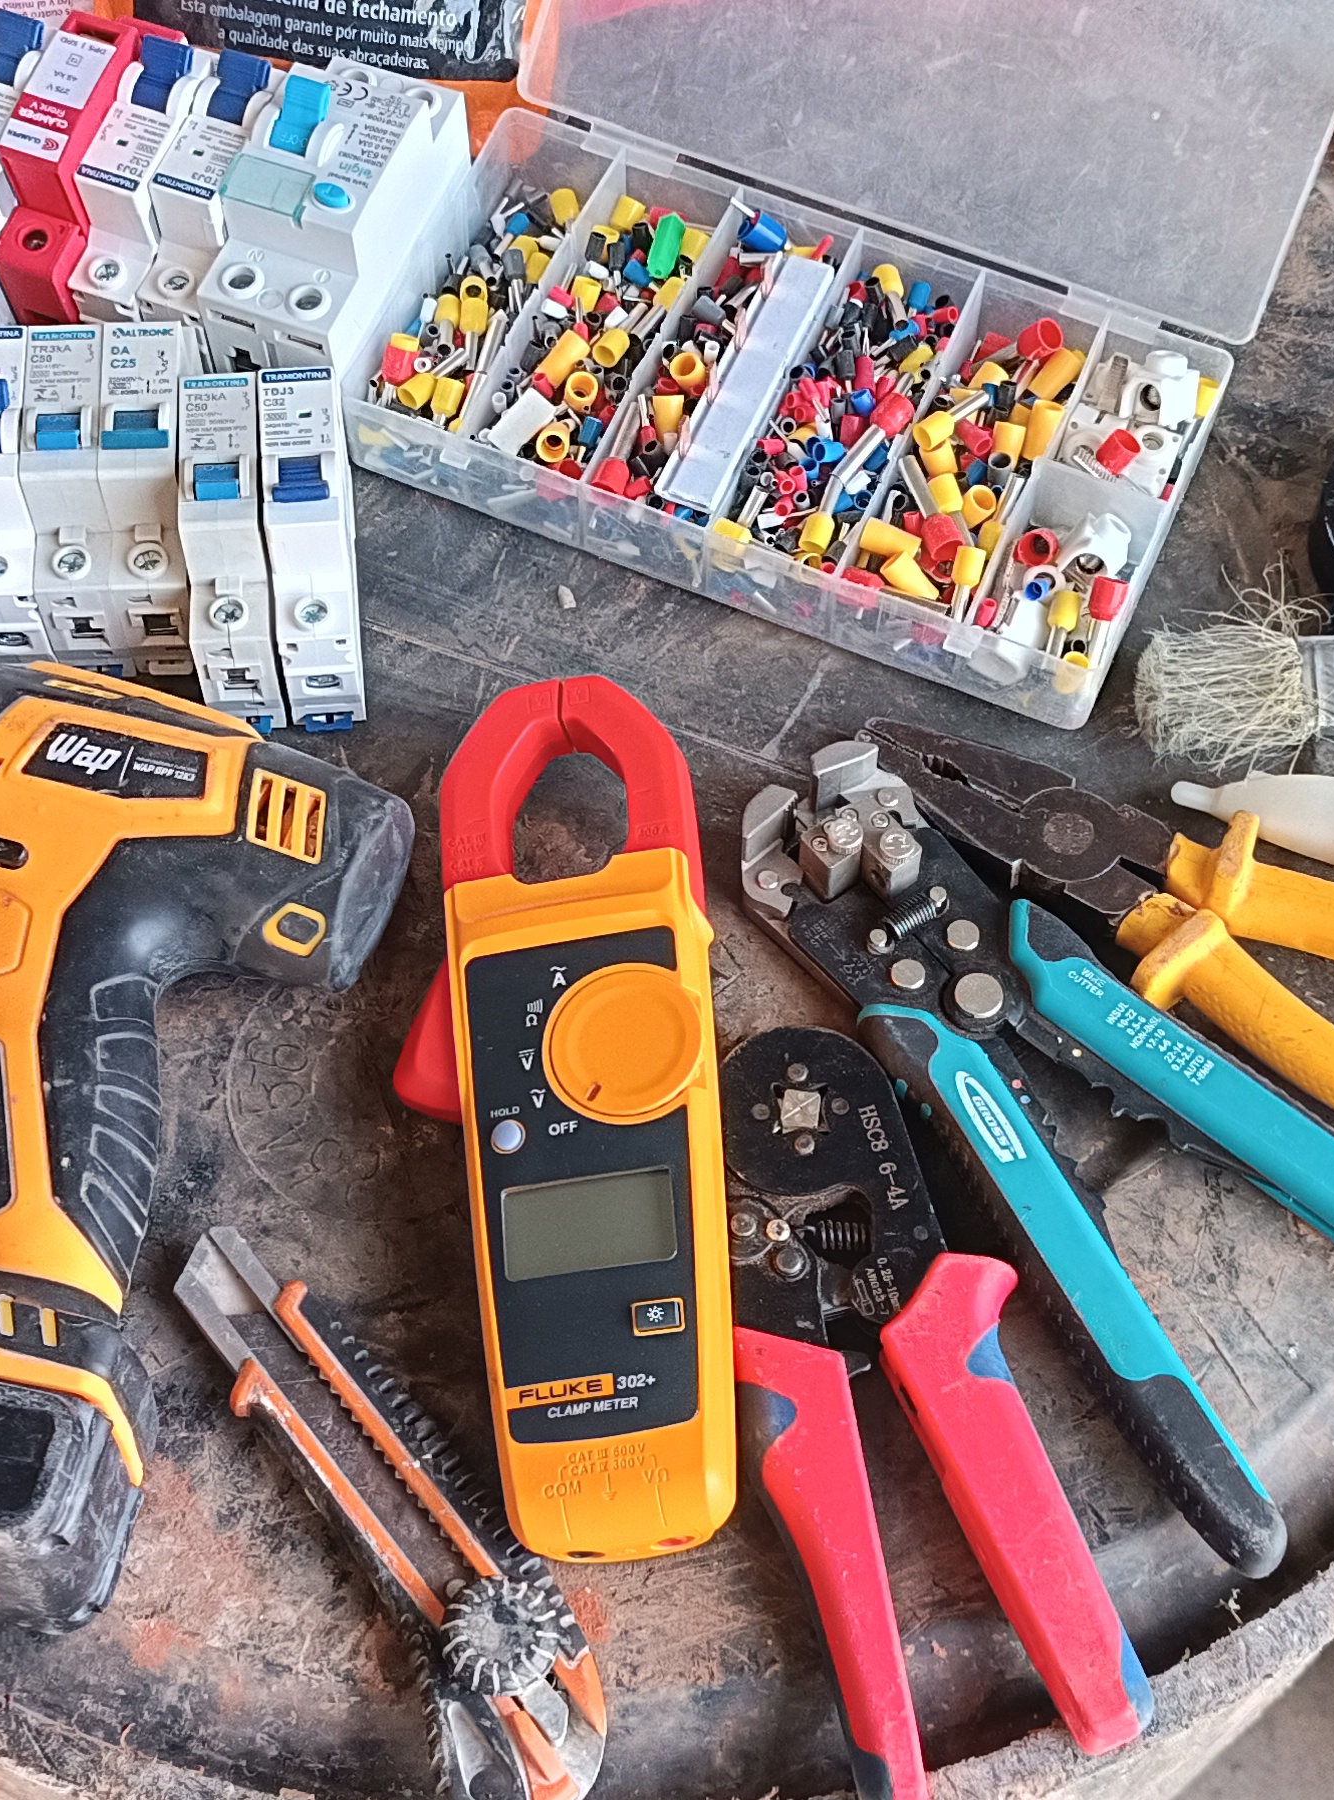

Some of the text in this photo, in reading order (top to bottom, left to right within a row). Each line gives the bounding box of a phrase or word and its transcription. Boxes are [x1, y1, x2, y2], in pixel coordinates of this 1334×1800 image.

[325, 0, 347, 14] de
[352, 0, 457, 26] fechamento
[180, 0, 207, 14] Esta
[210, 2, 281, 28] embalagem
[284, 17, 334, 36] garante
[335, 26, 358, 42] por
[360, 28, 397, 45] muito
[399, 32, 428, 49] mais
[217, 28, 430, 70] a qualidade das suas abraçadeiras.
[17, 105, 69, 129] CLAMPER
[79, 165, 136, 190] TRAMONTINA
[339, 161, 374, 180] elgin
[156, 175, 212, 197] TRAMONTINA
[32, 331, 94, 341] TRAMONTINA
[30, 344, 73, 355] TR3kA
[30, 354, 53, 364] C50
[110, 346, 131, 356] DA
[110, 358, 137, 369] C25
[185, 380, 246, 388] TRAMONTINA
[265, 371, 329, 382] TRAMONTINA
[185, 392, 228, 402] TR3kA
[262, 386, 295, 397] TDJ3
[263, 397, 286, 407] C32
[185, 403, 209, 412] C50
[46, 733, 122, 775] Wap
[1068, 970, 1105, 998] CUTTER
[1105, 1002, 1129, 1025] INSUL
[1117, 1009, 1138, 1028] 10-22
[1145, 1029, 1166, 1049] 12-10
[1183, 1055, 1205, 1079] AUTO
[490, 1106, 521, 1118] HOLD
[971, 1095, 1011, 1147] GROSS
[548, 1120, 578, 1136] OFF
[858, 1104, 910, 1211] HSC8 6-4A
[519, 1373, 656, 1404] FLUKE 302+
[547, 1396, 639, 1419] CLAMP METER
[568, 1450, 593, 1464] CAT
[613, 1444, 636, 1458] 600
[637, 1442, 646, 1454] V
[570, 1462, 595, 1477] CAT
[613, 1456, 636, 1470] 300
[637, 1454, 646, 1467] V
[542, 1479, 582, 1500] COM
